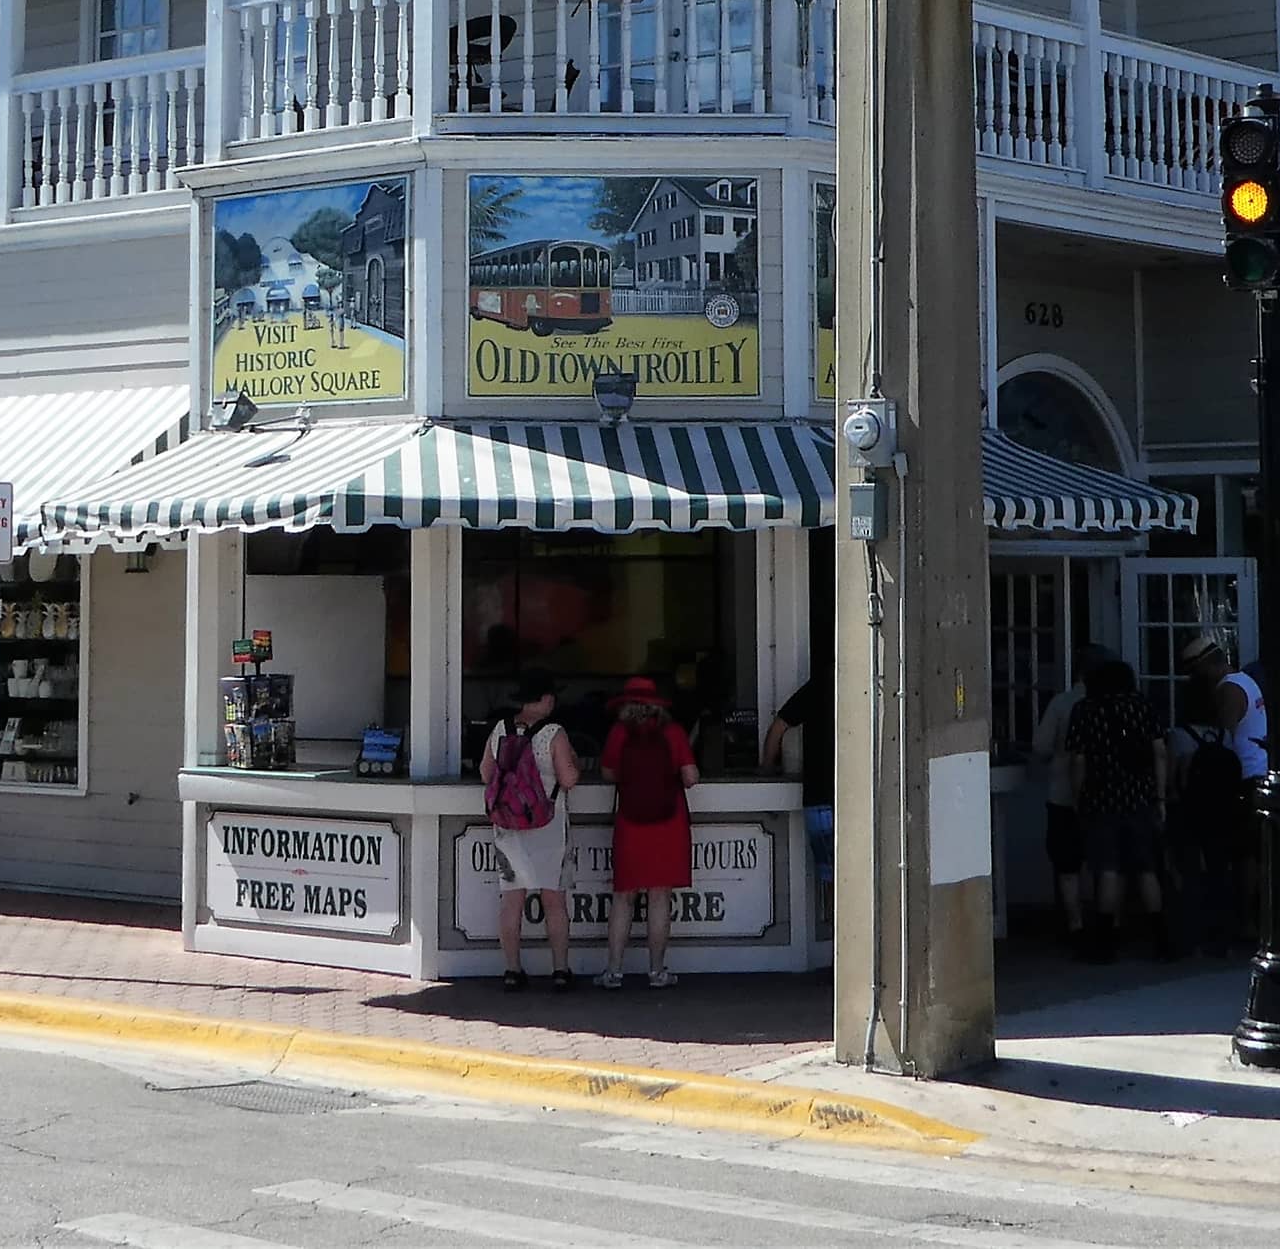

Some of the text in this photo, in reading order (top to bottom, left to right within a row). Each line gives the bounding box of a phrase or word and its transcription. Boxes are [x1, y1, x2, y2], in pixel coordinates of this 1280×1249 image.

[1025, 302, 1064, 329] 628
[253, 325, 298, 347] VISIT
[550, 337, 686, 349] See The Best First
[236, 348, 317, 372] HISTORIC
[476, 338, 748, 384] OLD TOWN TROLLEY
[225, 370, 381, 398] MALLORY SQUARE
[222, 825, 383, 866] INFORMATION
[472, 838, 757, 872] OL TOURS
[236, 879, 368, 919] FREE MAPS
[500, 893, 613, 924] ORD
